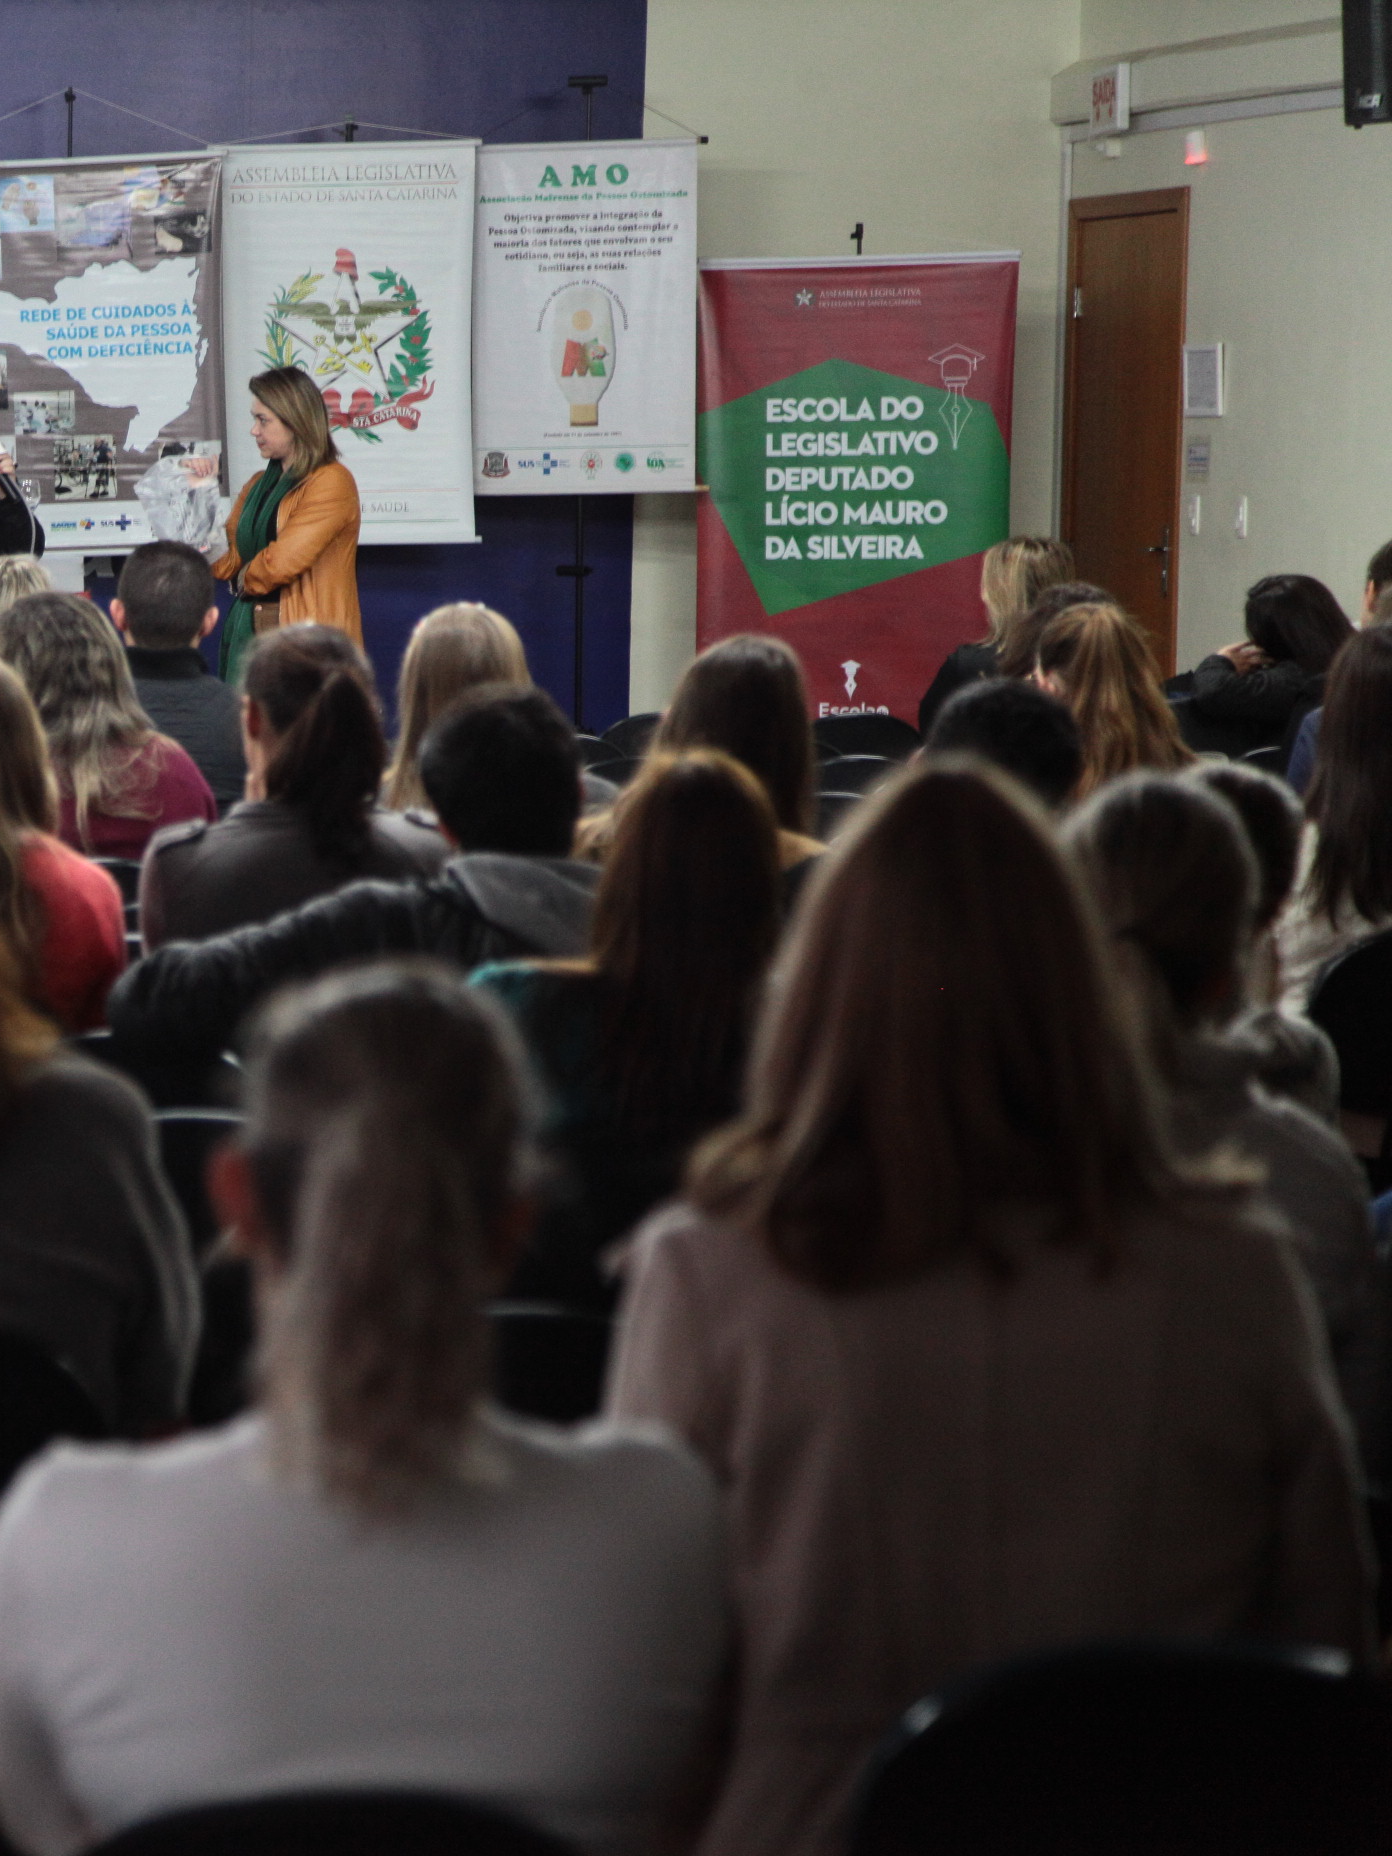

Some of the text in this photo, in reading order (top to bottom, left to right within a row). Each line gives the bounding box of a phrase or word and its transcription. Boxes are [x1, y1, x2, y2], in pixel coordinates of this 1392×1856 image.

[232, 163, 457, 183] ASSEMBLEIA LEGISLATIVA
[231, 187, 457, 204] DO ESTADO DE SANTA CATARINA
[504, 213, 543, 224] Objetiva
[545, 212, 591, 223] promover
[651, 209, 663, 218] da
[488, 227, 518, 236] Pessoa
[580, 224, 615, 233] visando
[617, 222, 671, 233] contemplar
[493, 240, 530, 248] maioria
[531, 239, 547, 248] dos
[549, 238, 582, 247] fatores
[584, 238, 601, 248] que
[603, 235, 648, 245] envolvam
[504, 251, 551, 261] cotidiano,
[553, 252, 565, 260] ou
[567, 251, 588, 261] seja,
[623, 248, 662, 260] relações
[538, 263, 585, 273] familiares
[594, 262, 628, 271] sociais.
[20, 299, 192, 323] REDE DE CUIDADOS À
[46, 322, 192, 341] SAÚDE DA PESSOA
[47, 338, 193, 360] COM DEFICIÊNCIA
[373, 406, 417, 424] CATARINA
[765, 396, 924, 423] ESCOLA DO
[765, 430, 938, 457] LEGISLATIVO
[765, 465, 915, 492] DEPUTADO
[361, 503, 368, 514] E
[765, 495, 948, 526] LÍCIO MAURO
[765, 535, 924, 560] DA SILVEIRA
